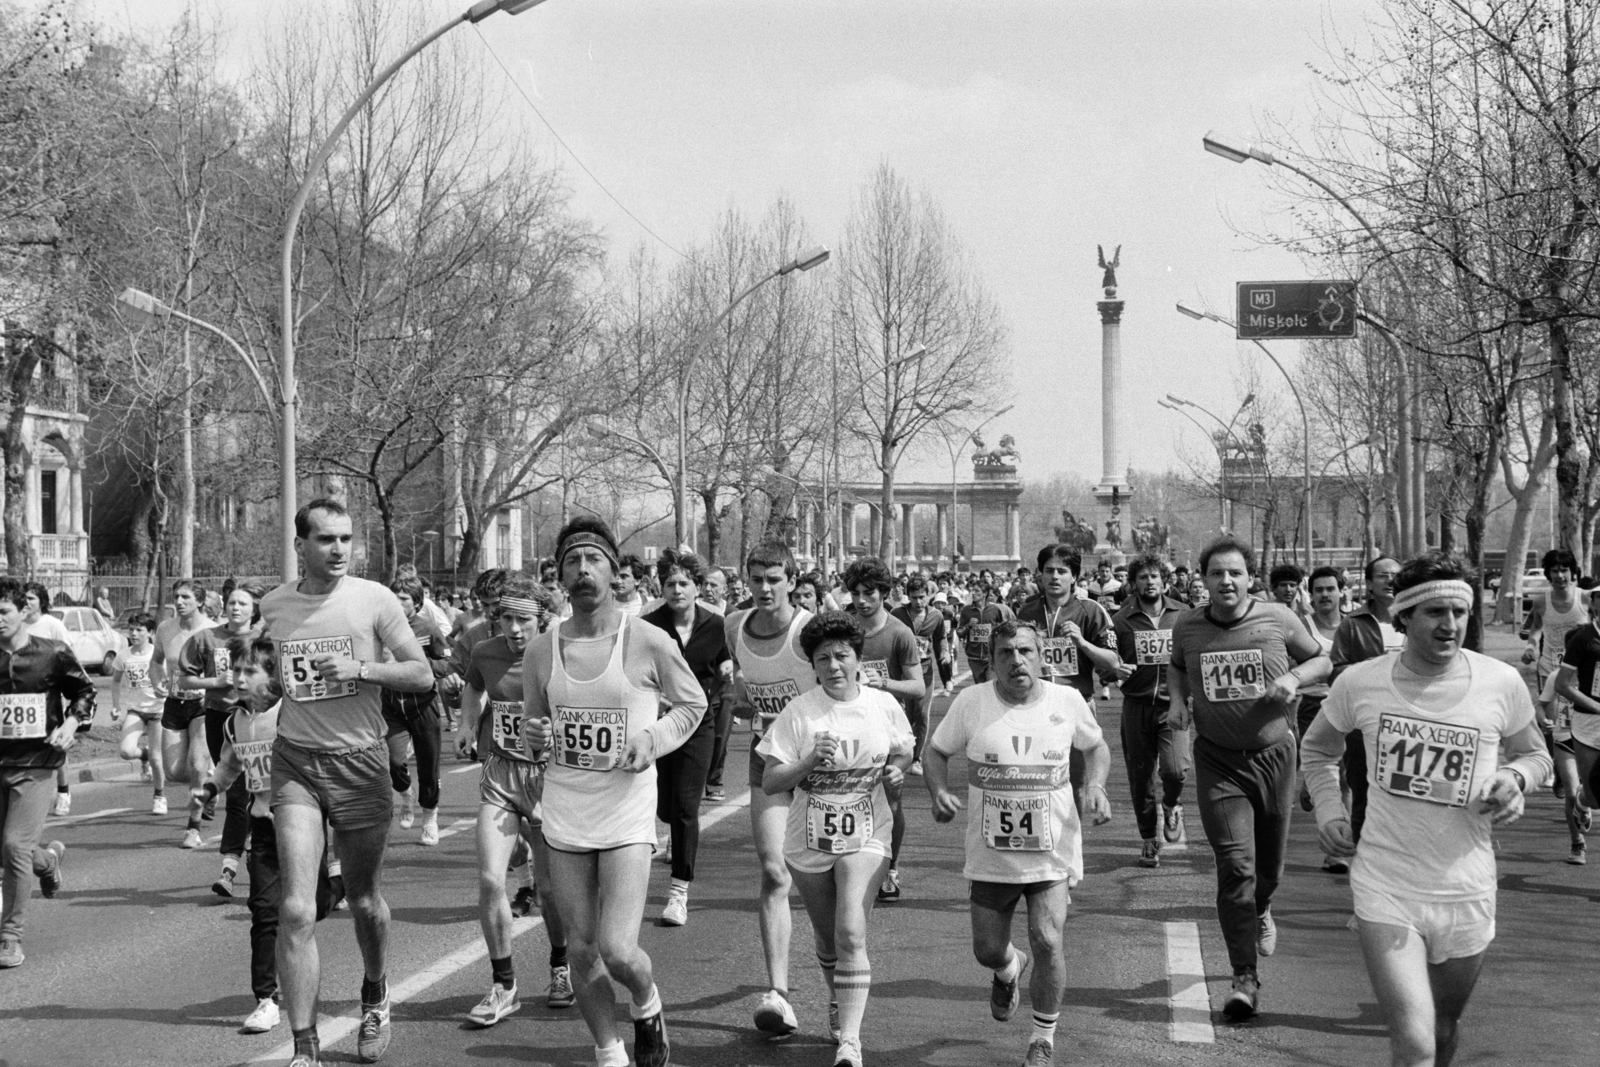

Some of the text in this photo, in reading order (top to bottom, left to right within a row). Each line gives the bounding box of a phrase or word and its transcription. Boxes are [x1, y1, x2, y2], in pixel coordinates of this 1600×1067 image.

[1255, 293, 1271, 305] M3
[1249, 313, 1308, 328] Miskolc
[971, 628, 990, 637] 3909
[281, 638, 350, 657] RANK XEROX
[1044, 648, 1072, 664] 601
[1201, 651, 1261, 666] RANK XEROX
[127, 668, 149, 681] 353
[292, 656, 325, 682] 59
[1209, 663, 1257, 687] 1140
[767, 682, 796, 696] XEROX
[2, 706, 36, 725] 288
[586, 711, 625, 725] XEROX
[564, 722, 612, 753] 550
[1381, 718, 1476, 749] RANK XEROX
[246, 742, 273, 755] XERO
[1378, 743, 1388, 782] IBUSZ
[1389, 738, 1464, 782] 1178
[807, 773, 834, 787] Alfa
[977, 766, 1050, 783] Alfa Romeo
[1457, 749, 1474, 804] MARATON
[808, 797, 838, 812] RANK
[984, 795, 1048, 811] RANK XEROX
[823, 813, 855, 836] 50
[1000, 811, 1033, 835] 54
